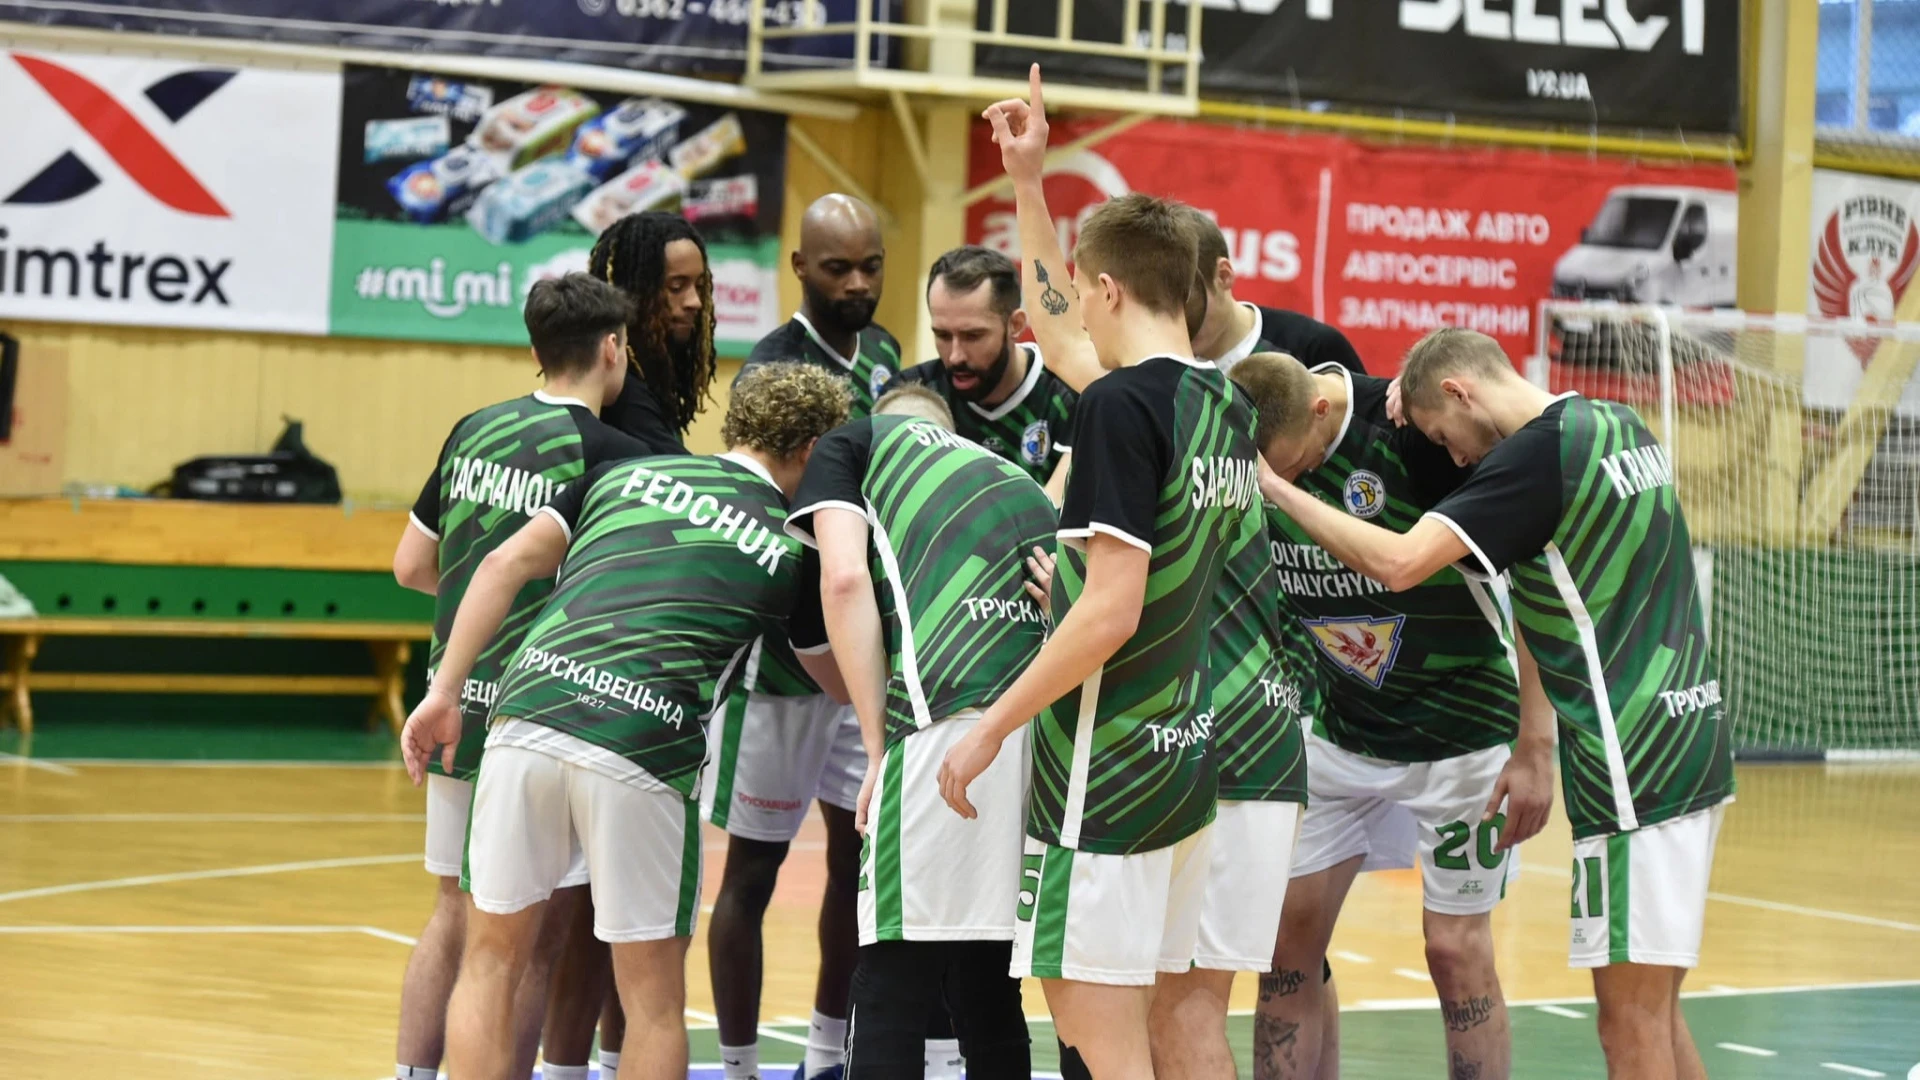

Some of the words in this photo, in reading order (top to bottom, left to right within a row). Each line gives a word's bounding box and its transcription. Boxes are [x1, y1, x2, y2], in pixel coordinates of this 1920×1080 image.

[1346, 202, 1471, 241] ПРОДАЖ
[1474, 210, 1550, 245] АВТО
[0, 227, 232, 305] imtrex
[1342, 250, 1518, 290] АВТОСЕРВІС
[1338, 297, 1530, 336] ЗАПЧАСТИНИ
[620, 467, 790, 577] FEDCHUK
[1277, 569, 1391, 598] HALYCHYN
[517, 647, 685, 731] ТРУСКАВЕЦЬКА
[576, 691, 606, 710] 1827
[1433, 813, 1506, 871] 20
[1571, 856, 1604, 918] 21
